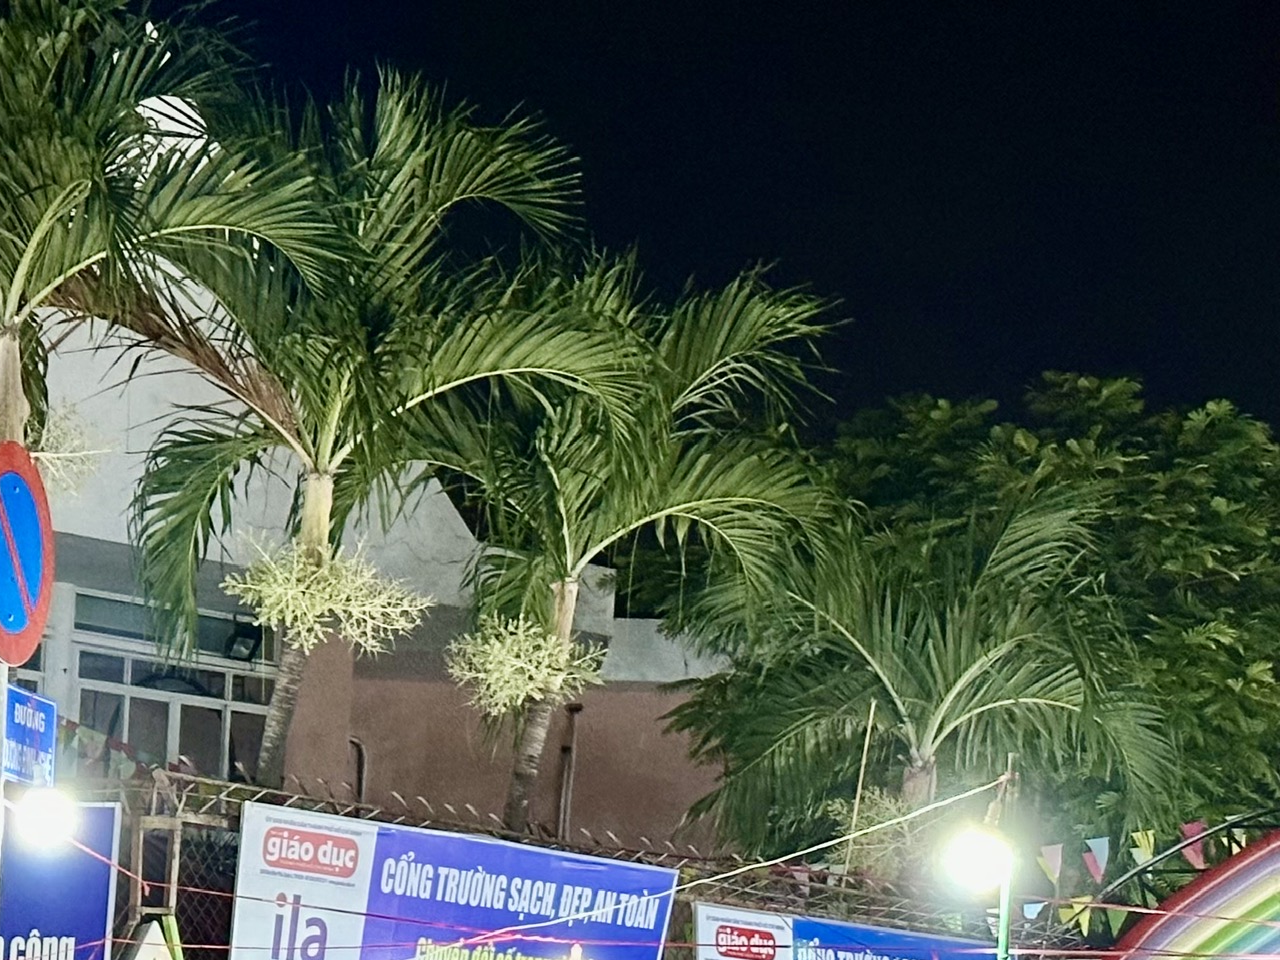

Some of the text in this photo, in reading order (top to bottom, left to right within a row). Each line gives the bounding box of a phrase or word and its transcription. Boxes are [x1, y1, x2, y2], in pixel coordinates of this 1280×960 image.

[13, 701, 46, 734] ĐƯỜNG
[265, 831, 314, 862] giáo
[317, 840, 356, 872] dục
[380, 851, 434, 898] CỔNG
[435, 865, 504, 917] TRƯỜNG
[507, 876, 556, 920] SẠCH,
[618, 889, 660, 930] TOÀN
[718, 927, 774, 959] giáo dục
